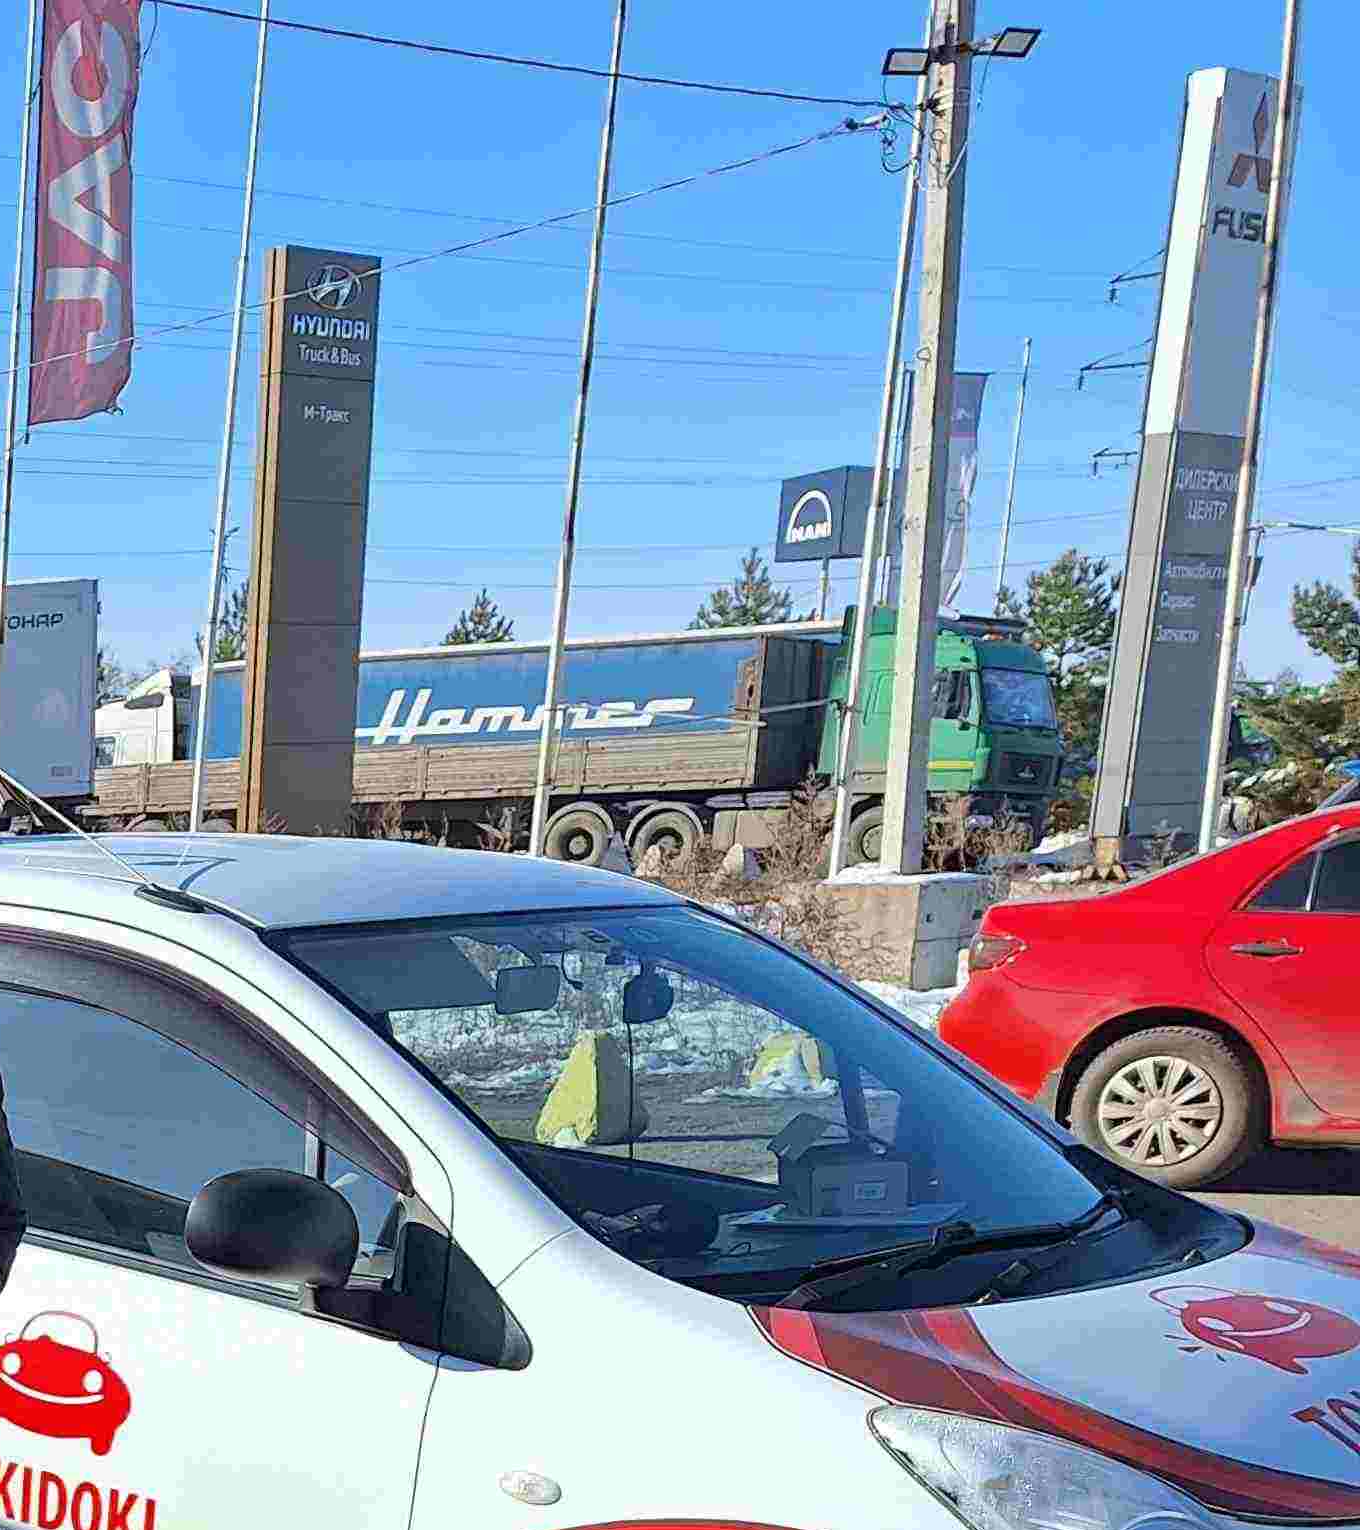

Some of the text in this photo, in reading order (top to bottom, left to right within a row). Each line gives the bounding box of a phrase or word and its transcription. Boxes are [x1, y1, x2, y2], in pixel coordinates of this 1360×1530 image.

[43, 17, 135, 367] JAC
[1211, 206, 1268, 244] FUS
[292, 314, 370, 340] HYUNDAI
[1176, 469, 1239, 490] ДИЛЕРСКИ
[791, 522, 831, 542] MAN
[0, 613, 64, 630] ОНАР
